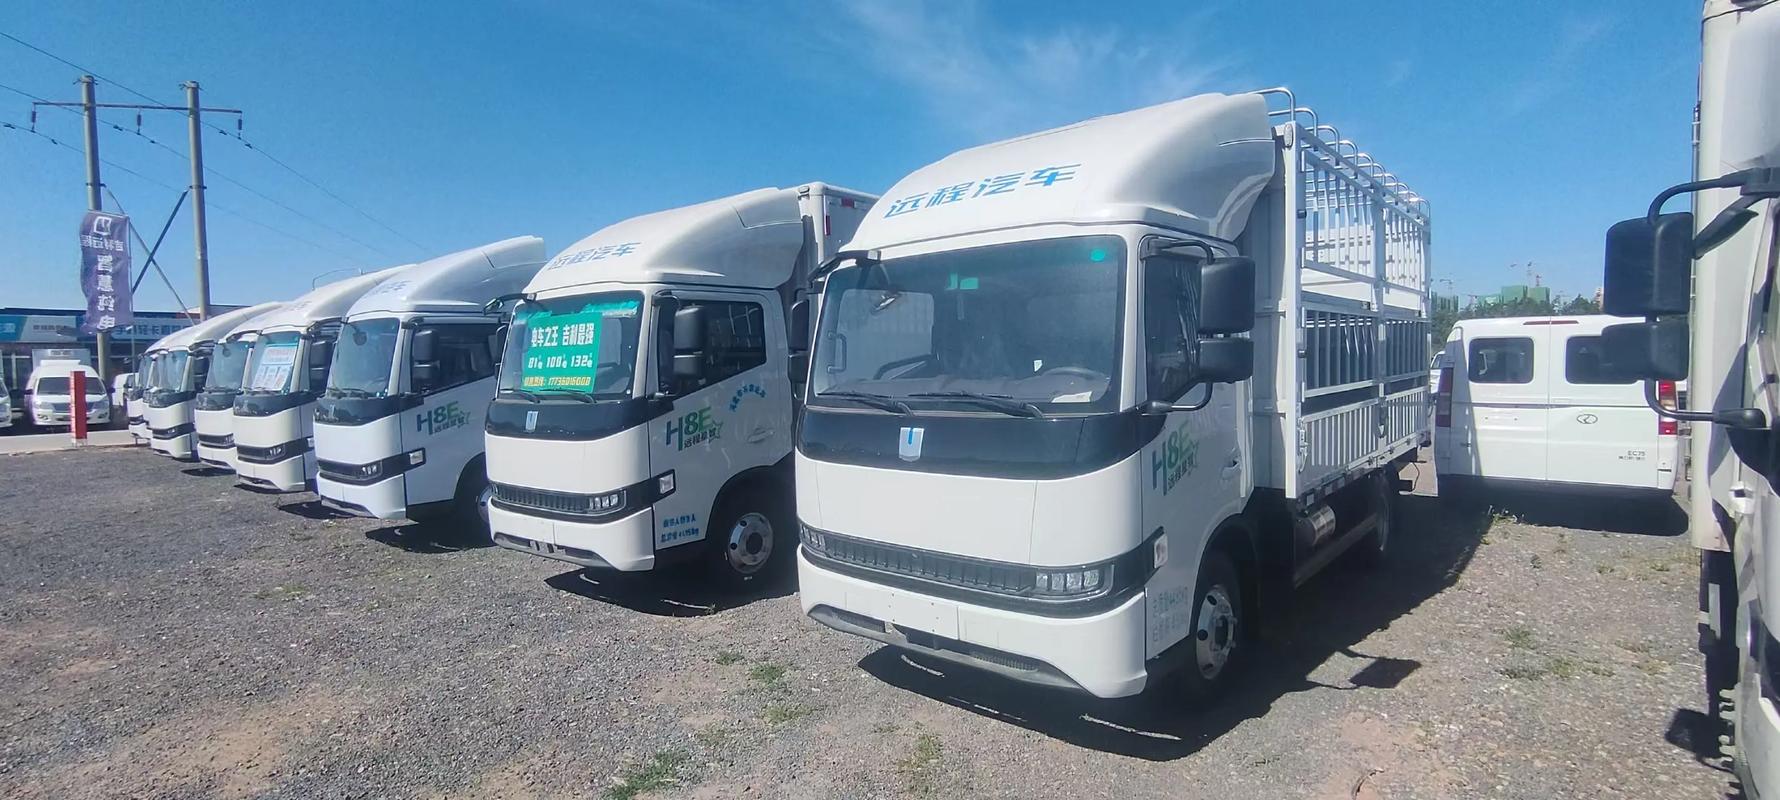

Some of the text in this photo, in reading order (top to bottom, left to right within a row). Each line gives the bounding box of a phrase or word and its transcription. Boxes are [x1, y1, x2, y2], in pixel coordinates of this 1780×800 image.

[883, 163, 1081, 218] 远程汽车
[546, 241, 641, 270] 远程汽车
[562, 322, 595, 346] 吉利最强
[416, 401, 459, 435] H8E
[666, 406, 711, 451] H8E
[1152, 420, 1191, 496] H8E
